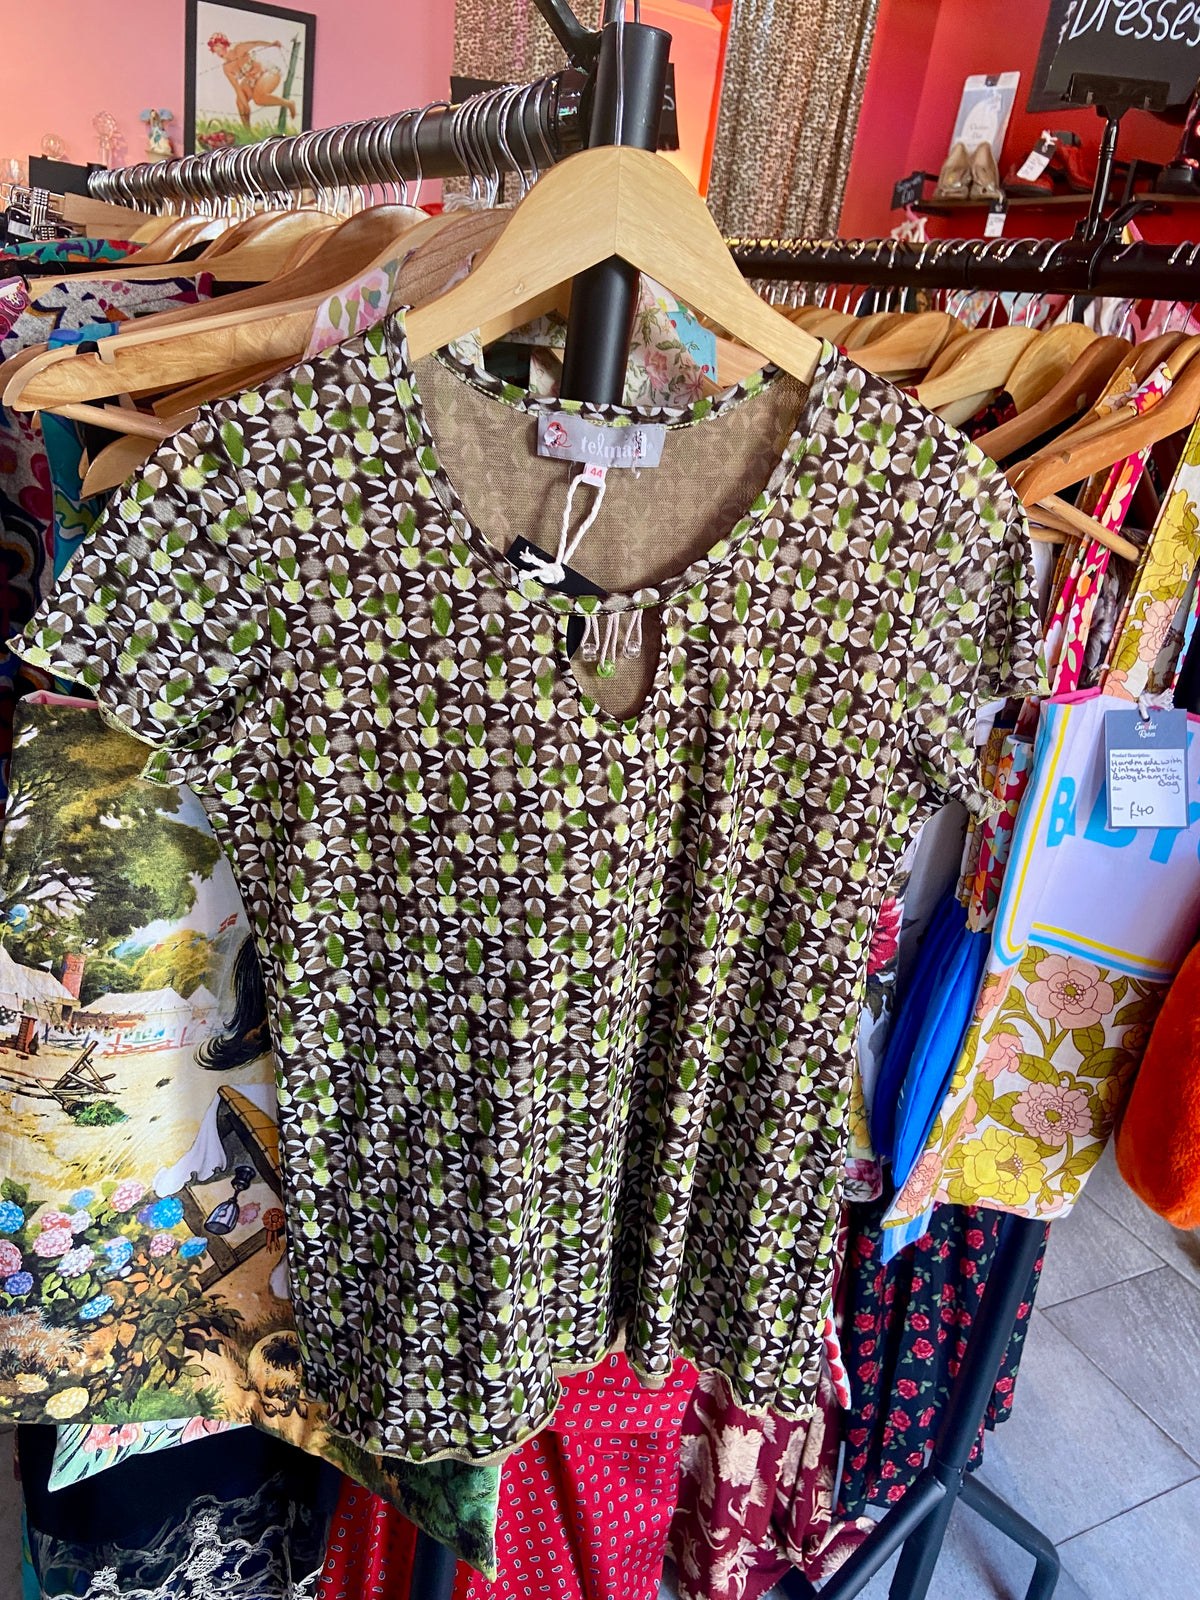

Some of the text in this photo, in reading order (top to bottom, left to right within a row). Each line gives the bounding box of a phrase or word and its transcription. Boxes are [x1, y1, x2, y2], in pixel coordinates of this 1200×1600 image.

[590, 467, 603, 478] 44
[1161, 757, 1182, 765] with
[1158, 779, 1180, 794] Bag
[1130, 801, 1154, 819] £40
